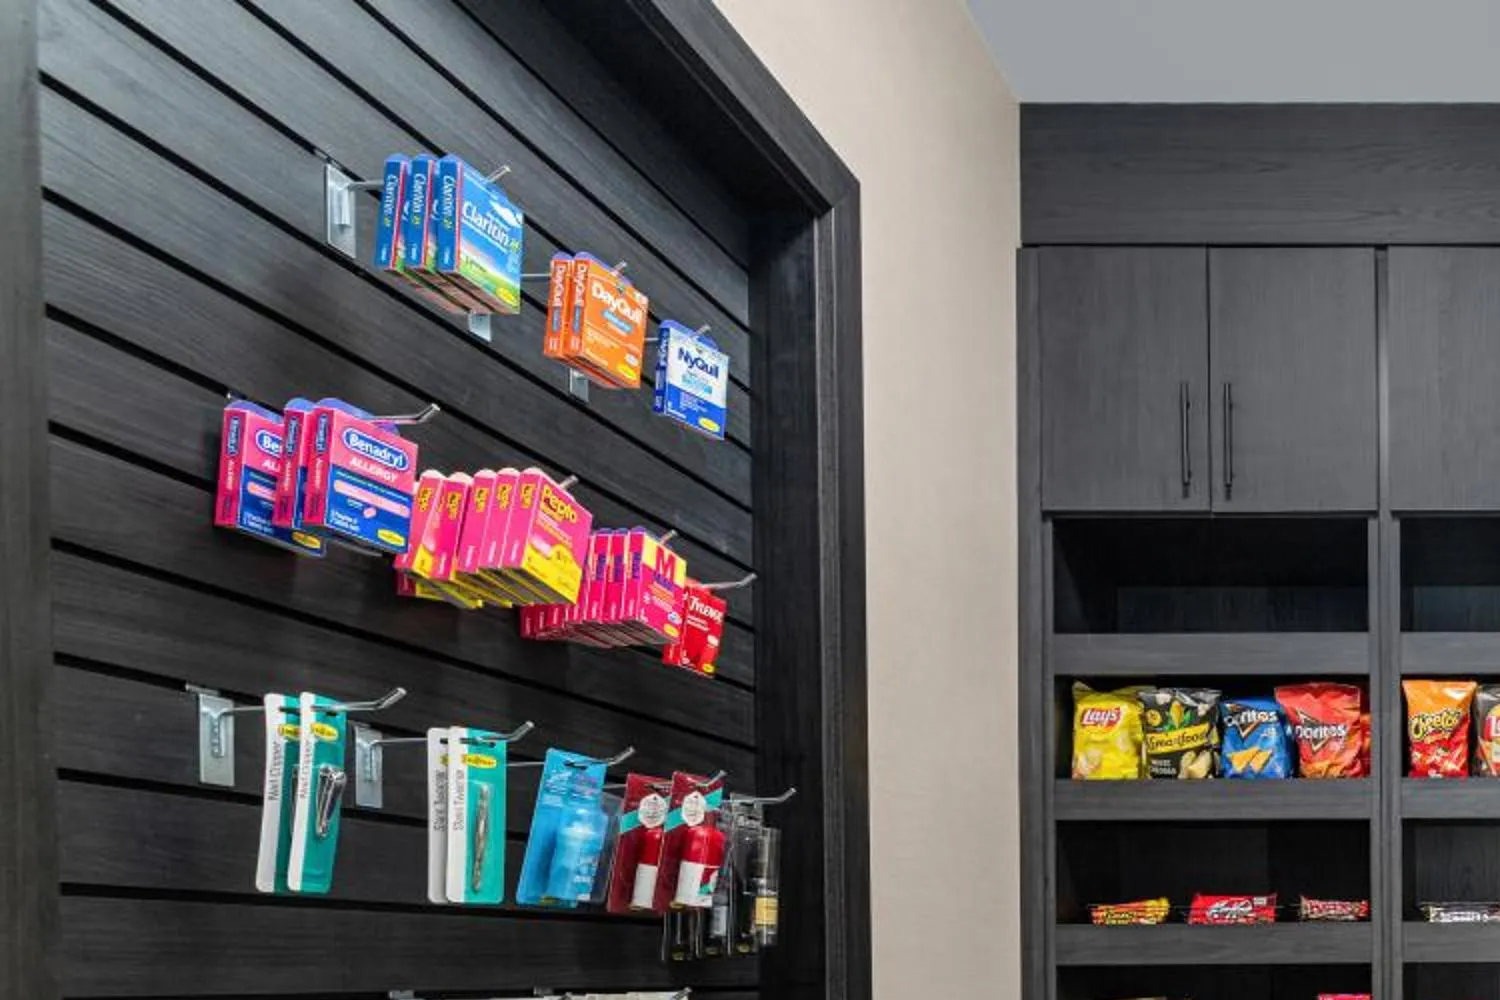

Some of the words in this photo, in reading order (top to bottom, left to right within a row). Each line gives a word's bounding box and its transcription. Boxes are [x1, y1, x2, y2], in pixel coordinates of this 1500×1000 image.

[463, 201, 510, 246] Claritin
[591, 281, 643, 325] DayQuil
[677, 347, 720, 379] NyQuil
[348, 432, 404, 469] Benadryl
[1294, 721, 1347, 740] Doritos
